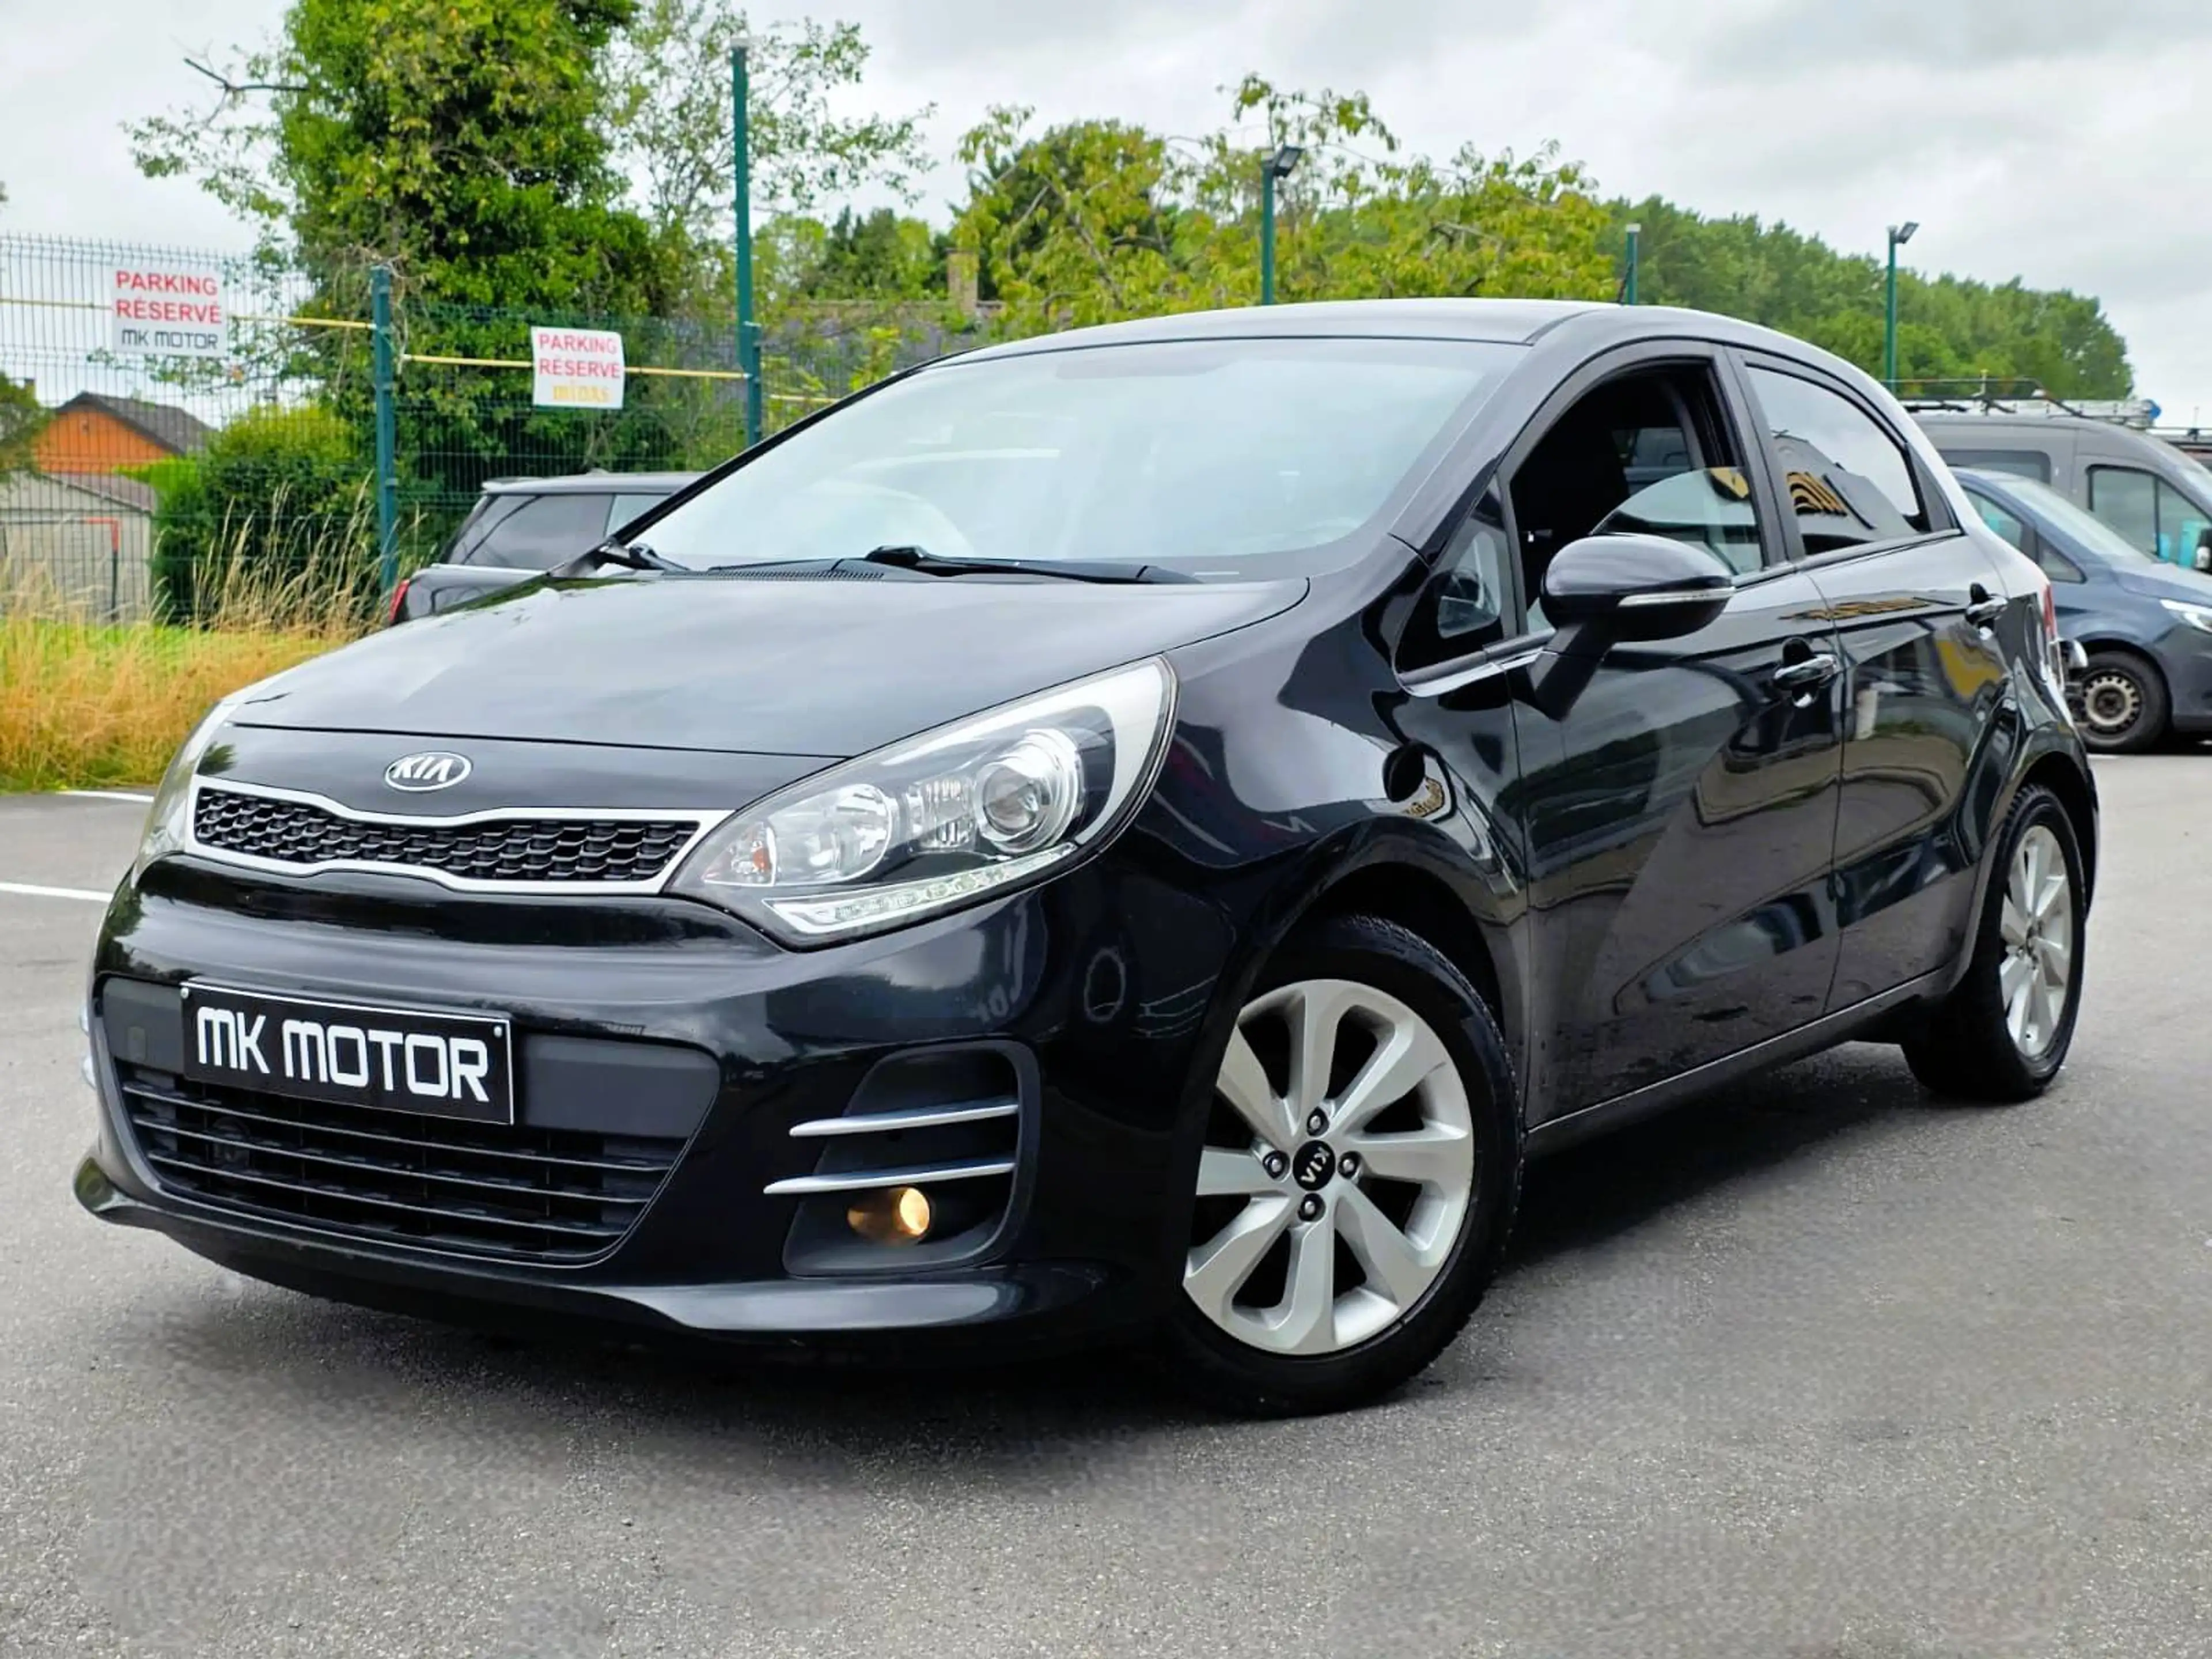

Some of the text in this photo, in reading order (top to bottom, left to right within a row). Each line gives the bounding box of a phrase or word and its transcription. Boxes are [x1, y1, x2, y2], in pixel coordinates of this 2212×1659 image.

[116, 270, 218, 296] PARKING
[122, 328, 219, 349] MK MOTOR
[539, 334, 618, 354] PARKING
[392, 756, 454, 782] KIA
[196, 1006, 490, 1102] MK MOTOR
